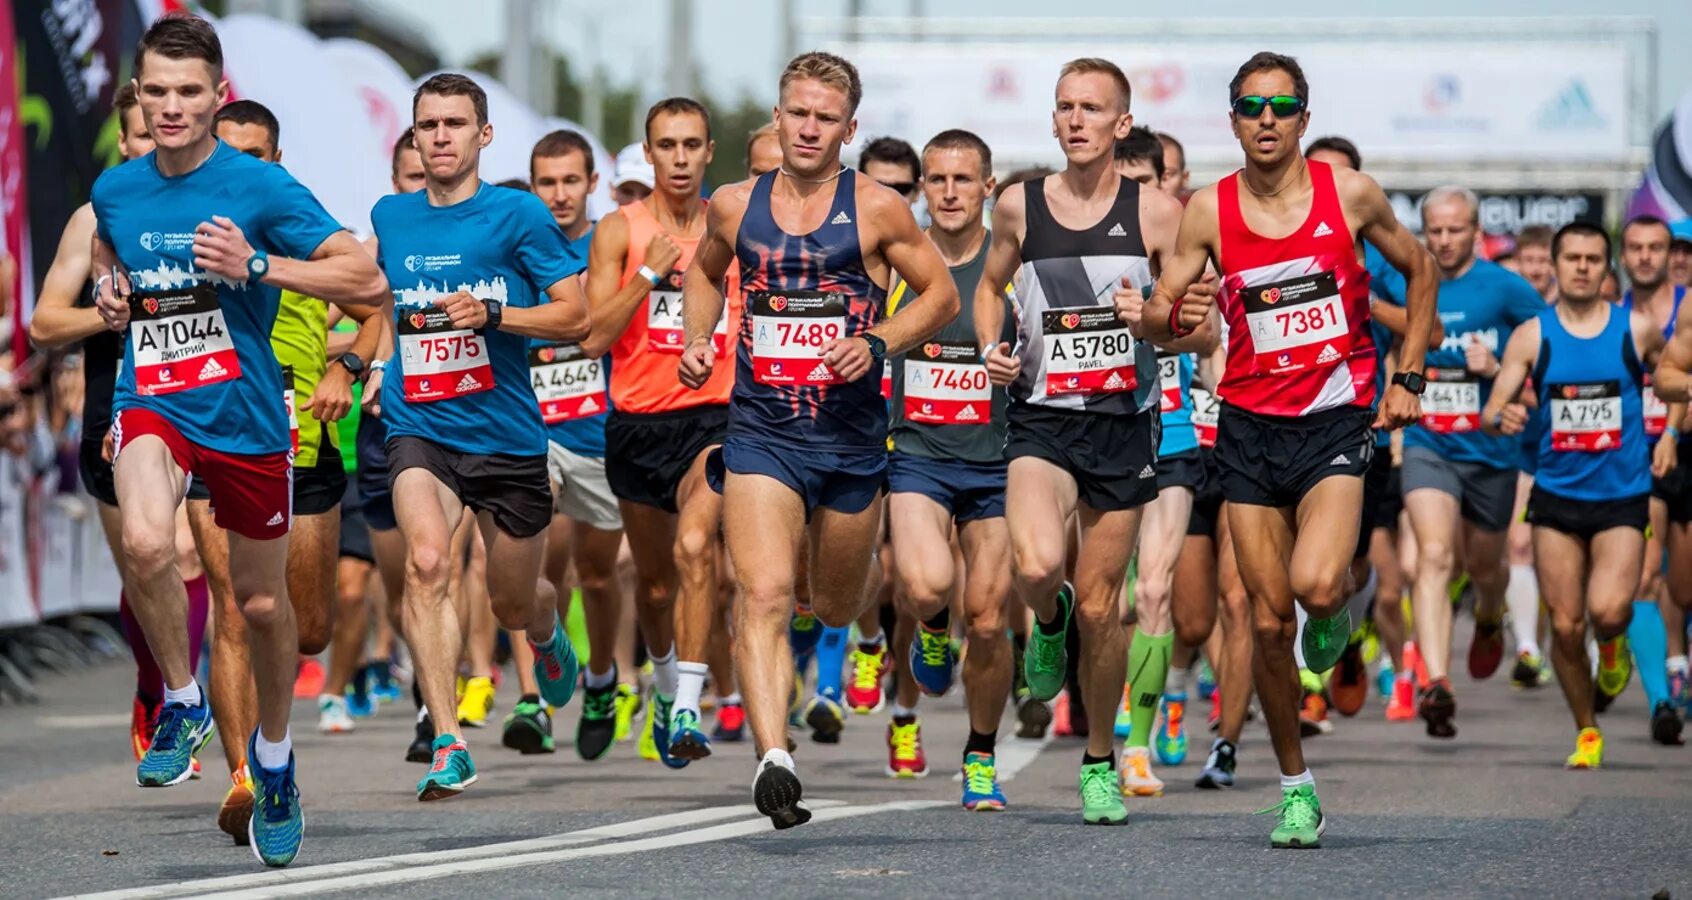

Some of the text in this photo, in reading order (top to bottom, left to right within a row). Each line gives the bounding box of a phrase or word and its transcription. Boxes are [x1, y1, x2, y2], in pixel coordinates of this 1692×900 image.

[653, 295, 670, 316] A
[1276, 302, 1338, 338] 7381
[777, 323, 839, 347] 7489
[1051, 333, 1129, 360] A 5780
[161, 341, 206, 361] ДМИТРИЙ
[420, 334, 480, 363] 7575
[533, 362, 599, 389] A 4649
[1078, 360, 1105, 369] PAVEL
[930, 368, 987, 390] 7460
[1560, 401, 1612, 422] A 795
